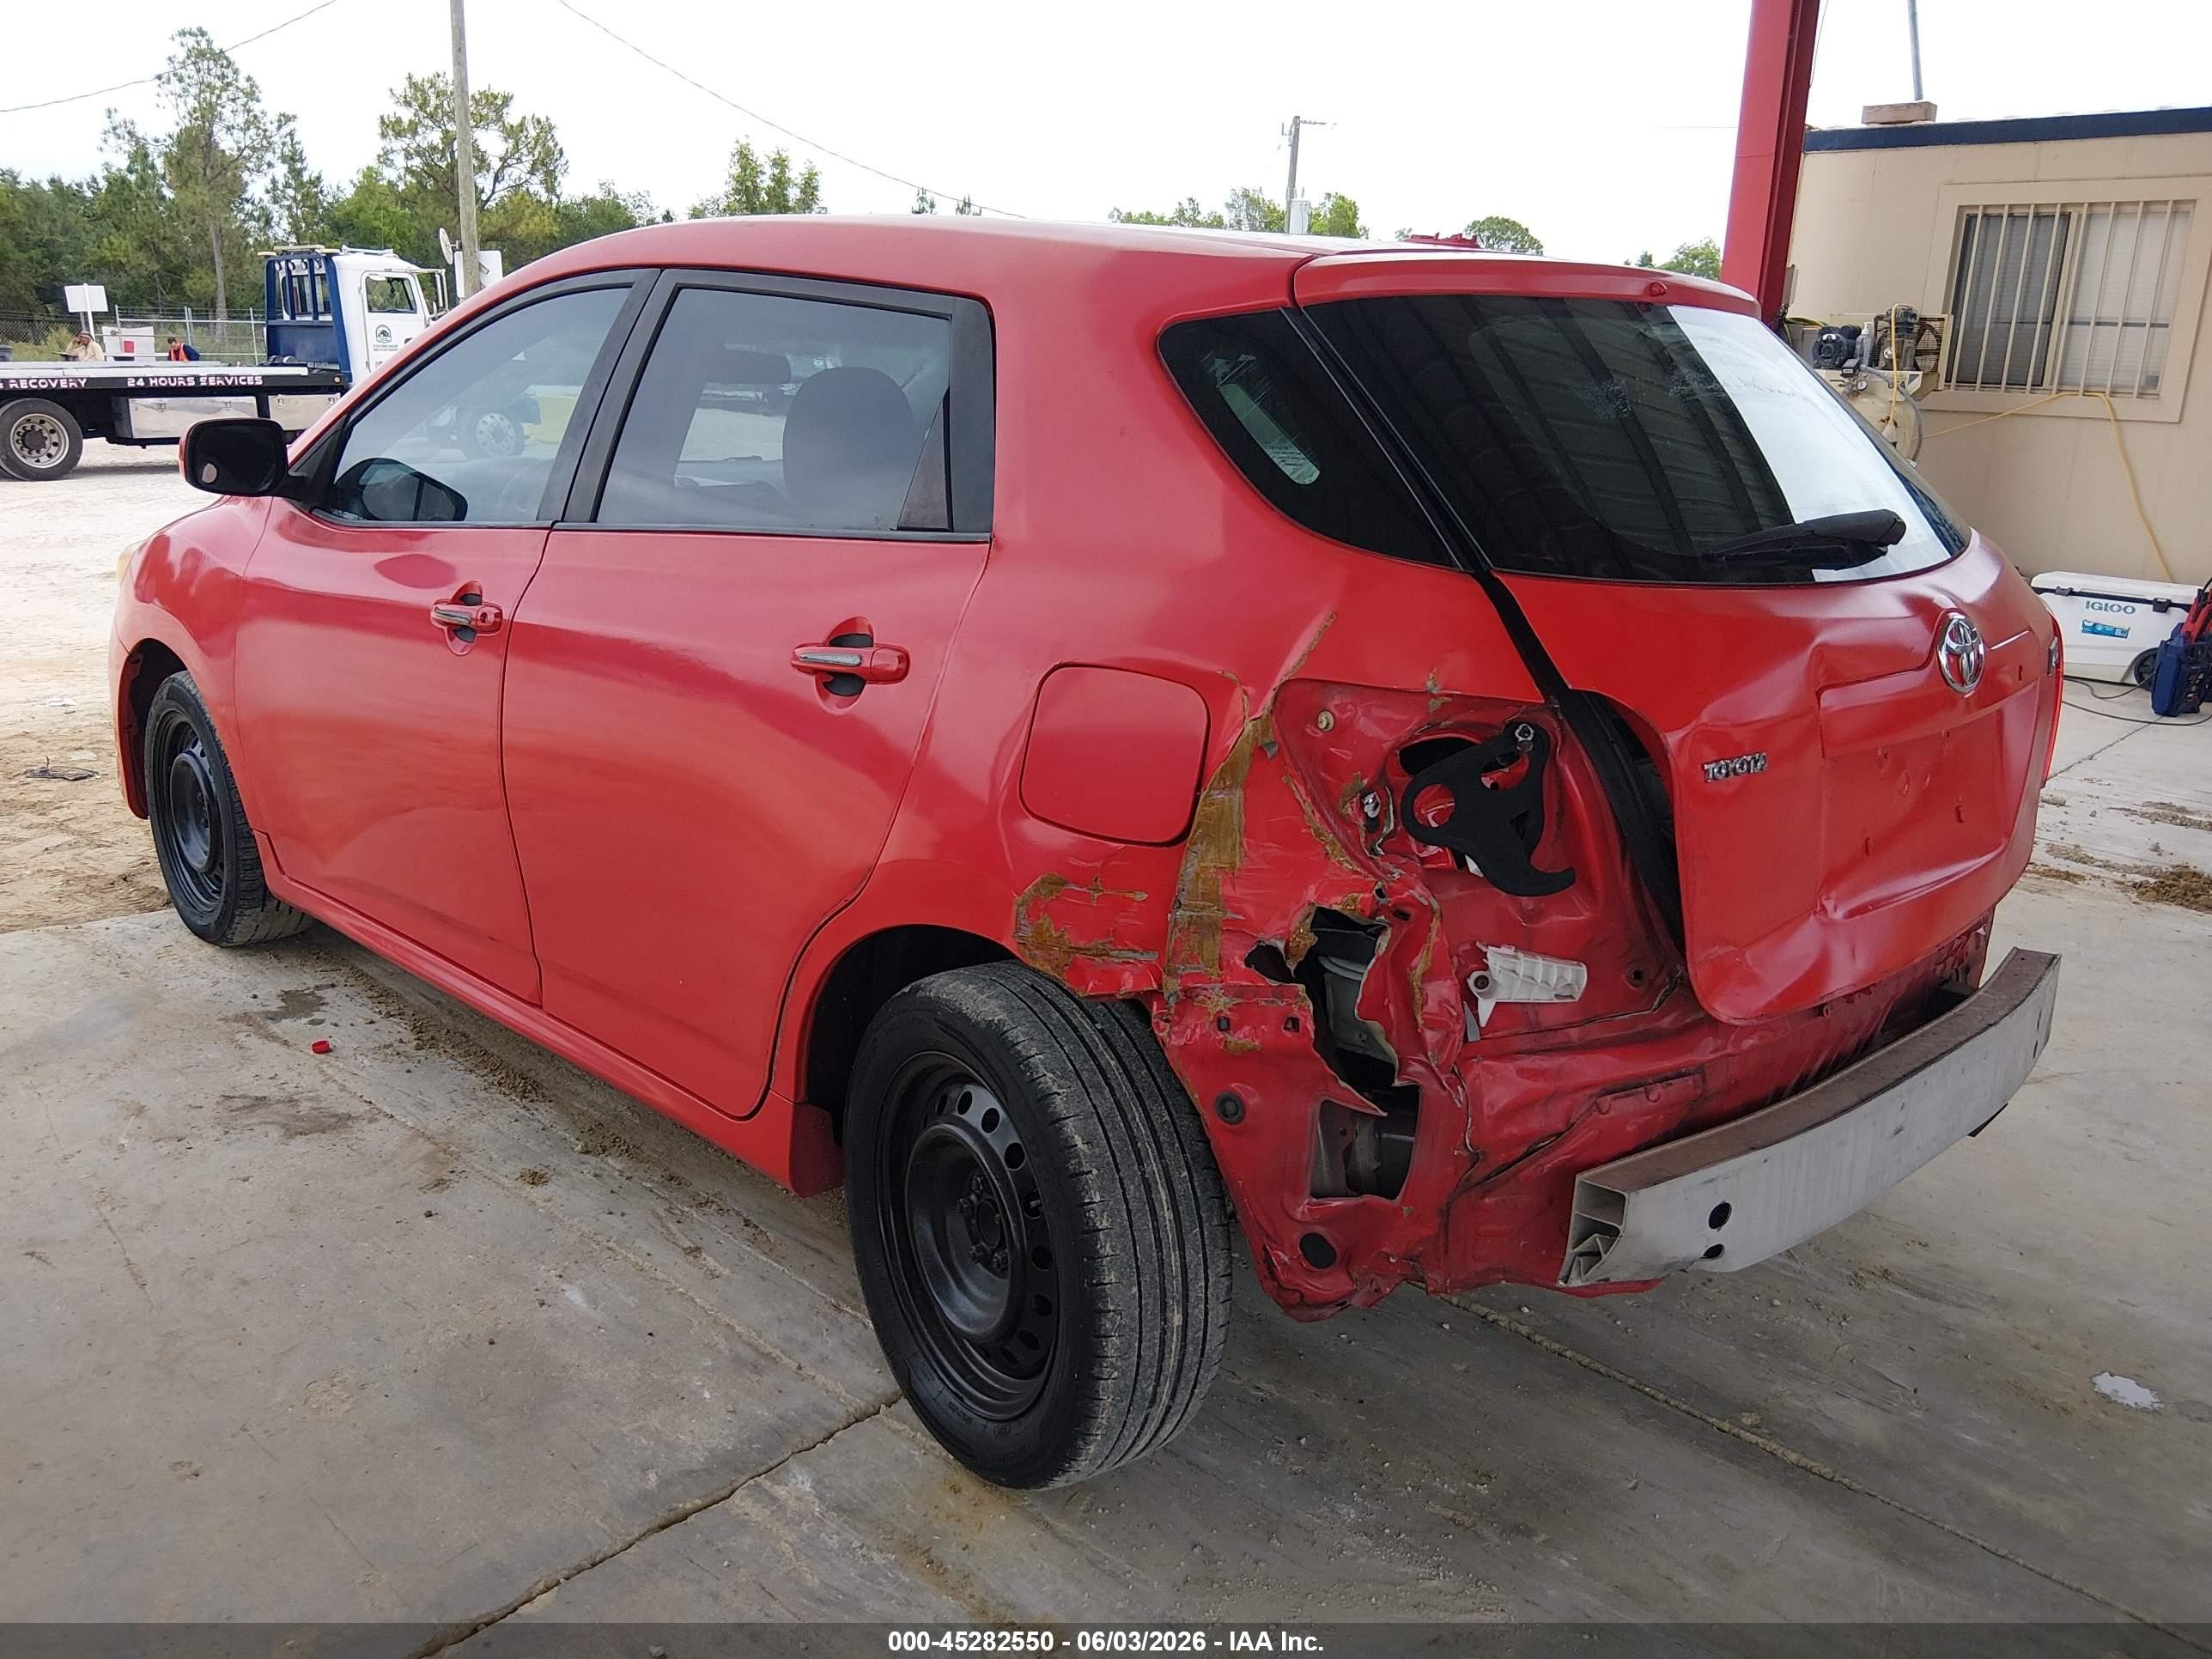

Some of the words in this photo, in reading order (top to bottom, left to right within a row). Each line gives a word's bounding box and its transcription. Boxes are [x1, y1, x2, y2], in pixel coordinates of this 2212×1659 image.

[9, 379, 87, 389] RECOVERY
[127, 378, 145, 386] 24
[149, 377, 196, 386] HOURS
[200, 376, 263, 386] SERVICES
[2085, 601, 2136, 614] IGLOO
[1704, 752, 1767, 782] TOYOTA
